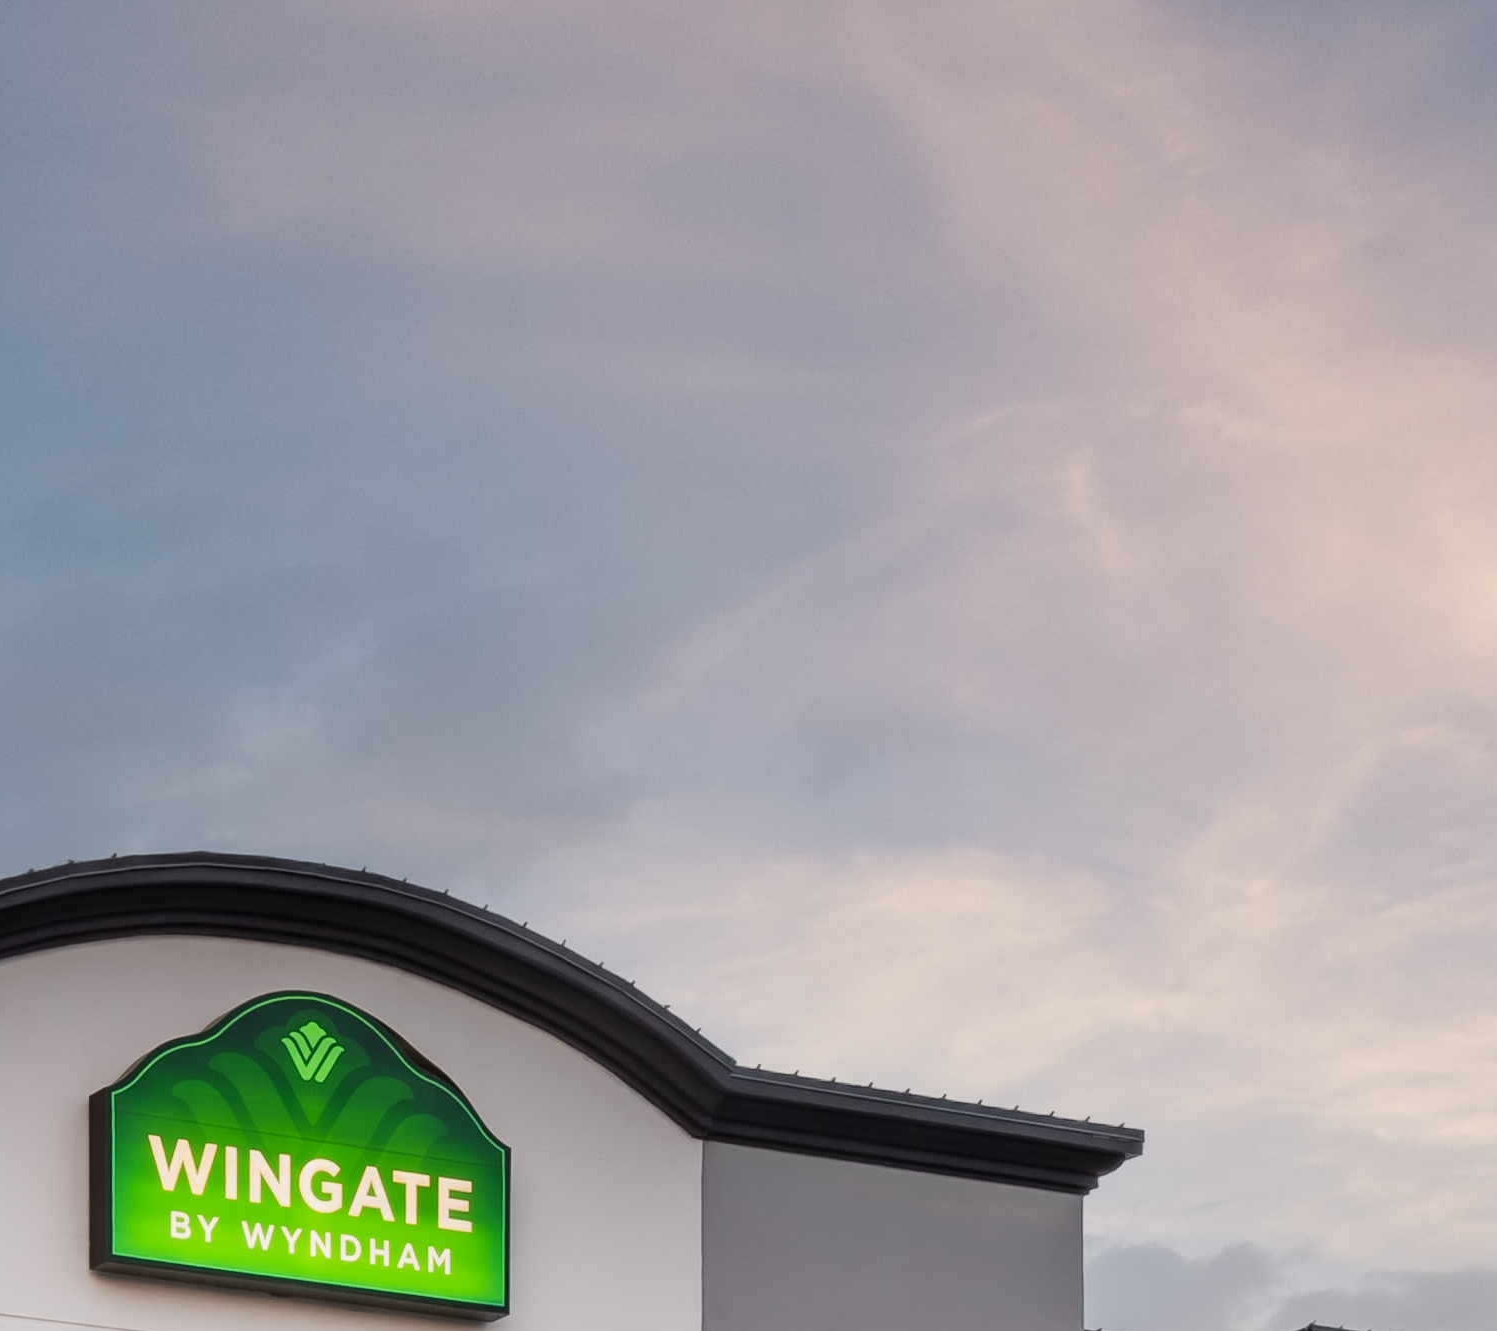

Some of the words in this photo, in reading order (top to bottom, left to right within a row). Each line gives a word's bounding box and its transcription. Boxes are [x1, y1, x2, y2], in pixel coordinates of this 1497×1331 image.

[147, 1134, 474, 1234] WINGATE
[169, 1210, 220, 1243] BY
[241, 1220, 452, 1275] WYNDHAM
